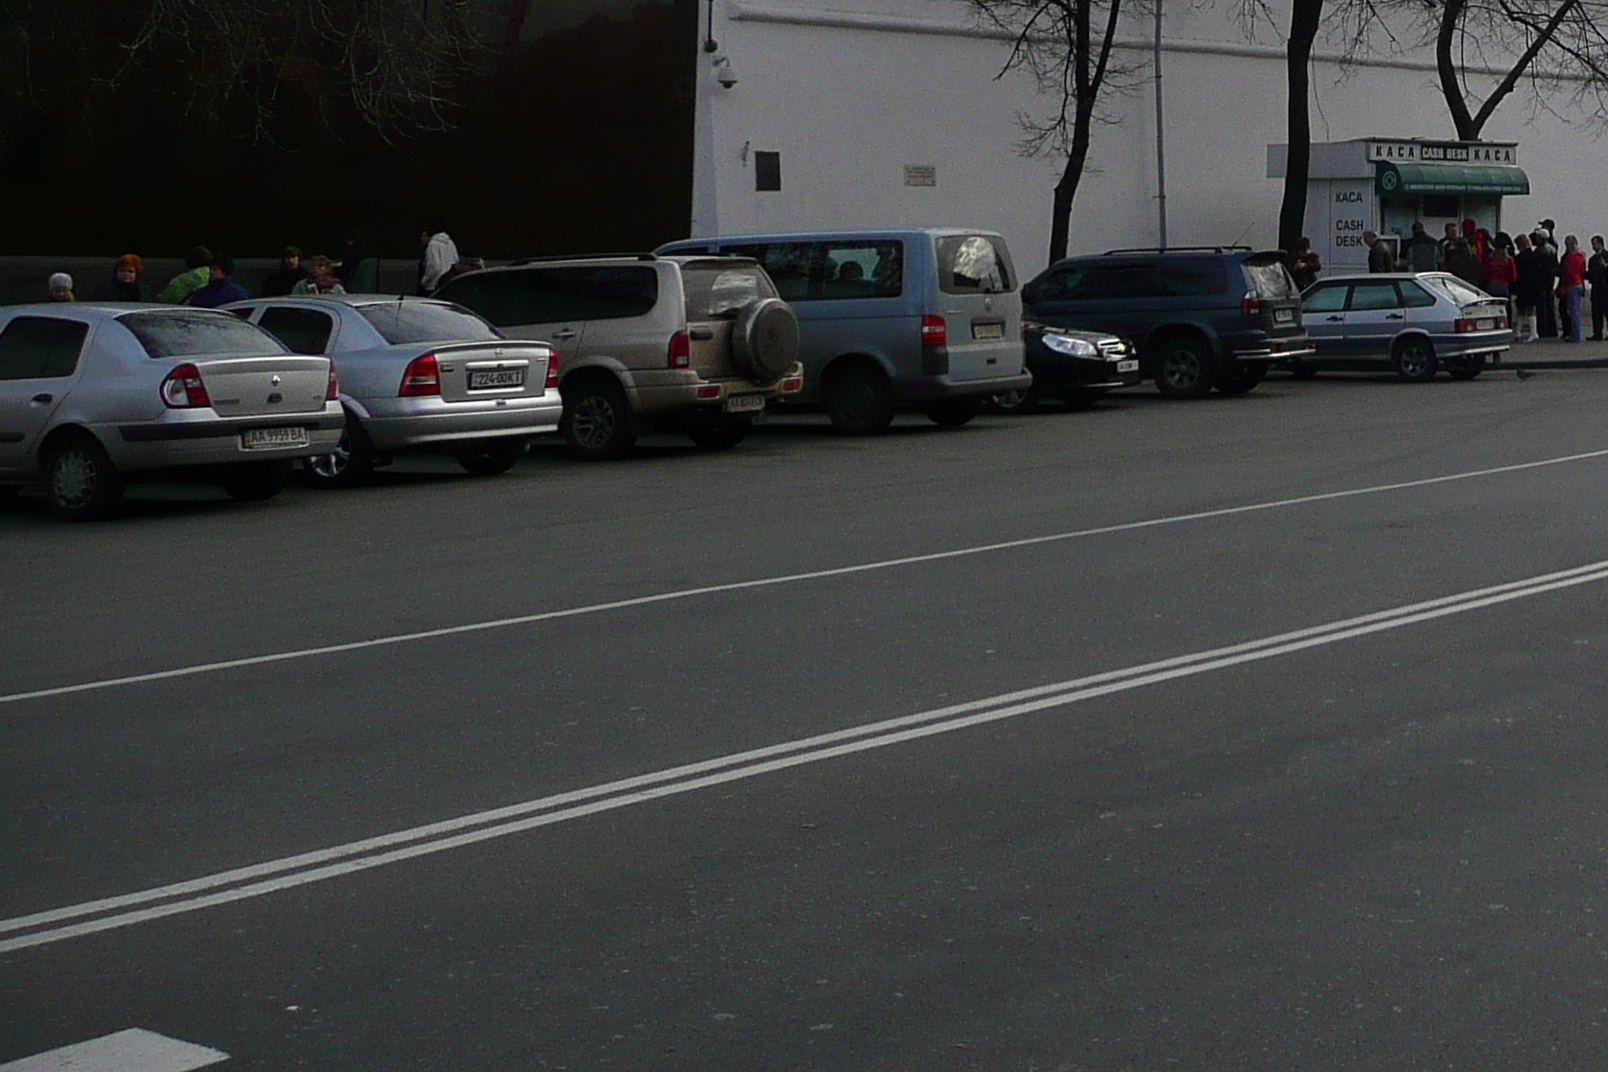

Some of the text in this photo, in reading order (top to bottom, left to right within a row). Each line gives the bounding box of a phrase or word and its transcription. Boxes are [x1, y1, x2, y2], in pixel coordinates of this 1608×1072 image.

[1376, 146, 1415, 158] КАСА
[1422, 147, 1469, 160] CASH DESK
[1474, 149, 1511, 162] КАСА
[1335, 191, 1363, 203] КАСА
[1336, 219, 1364, 231] CASH
[1336, 235, 1363, 247] DESK
